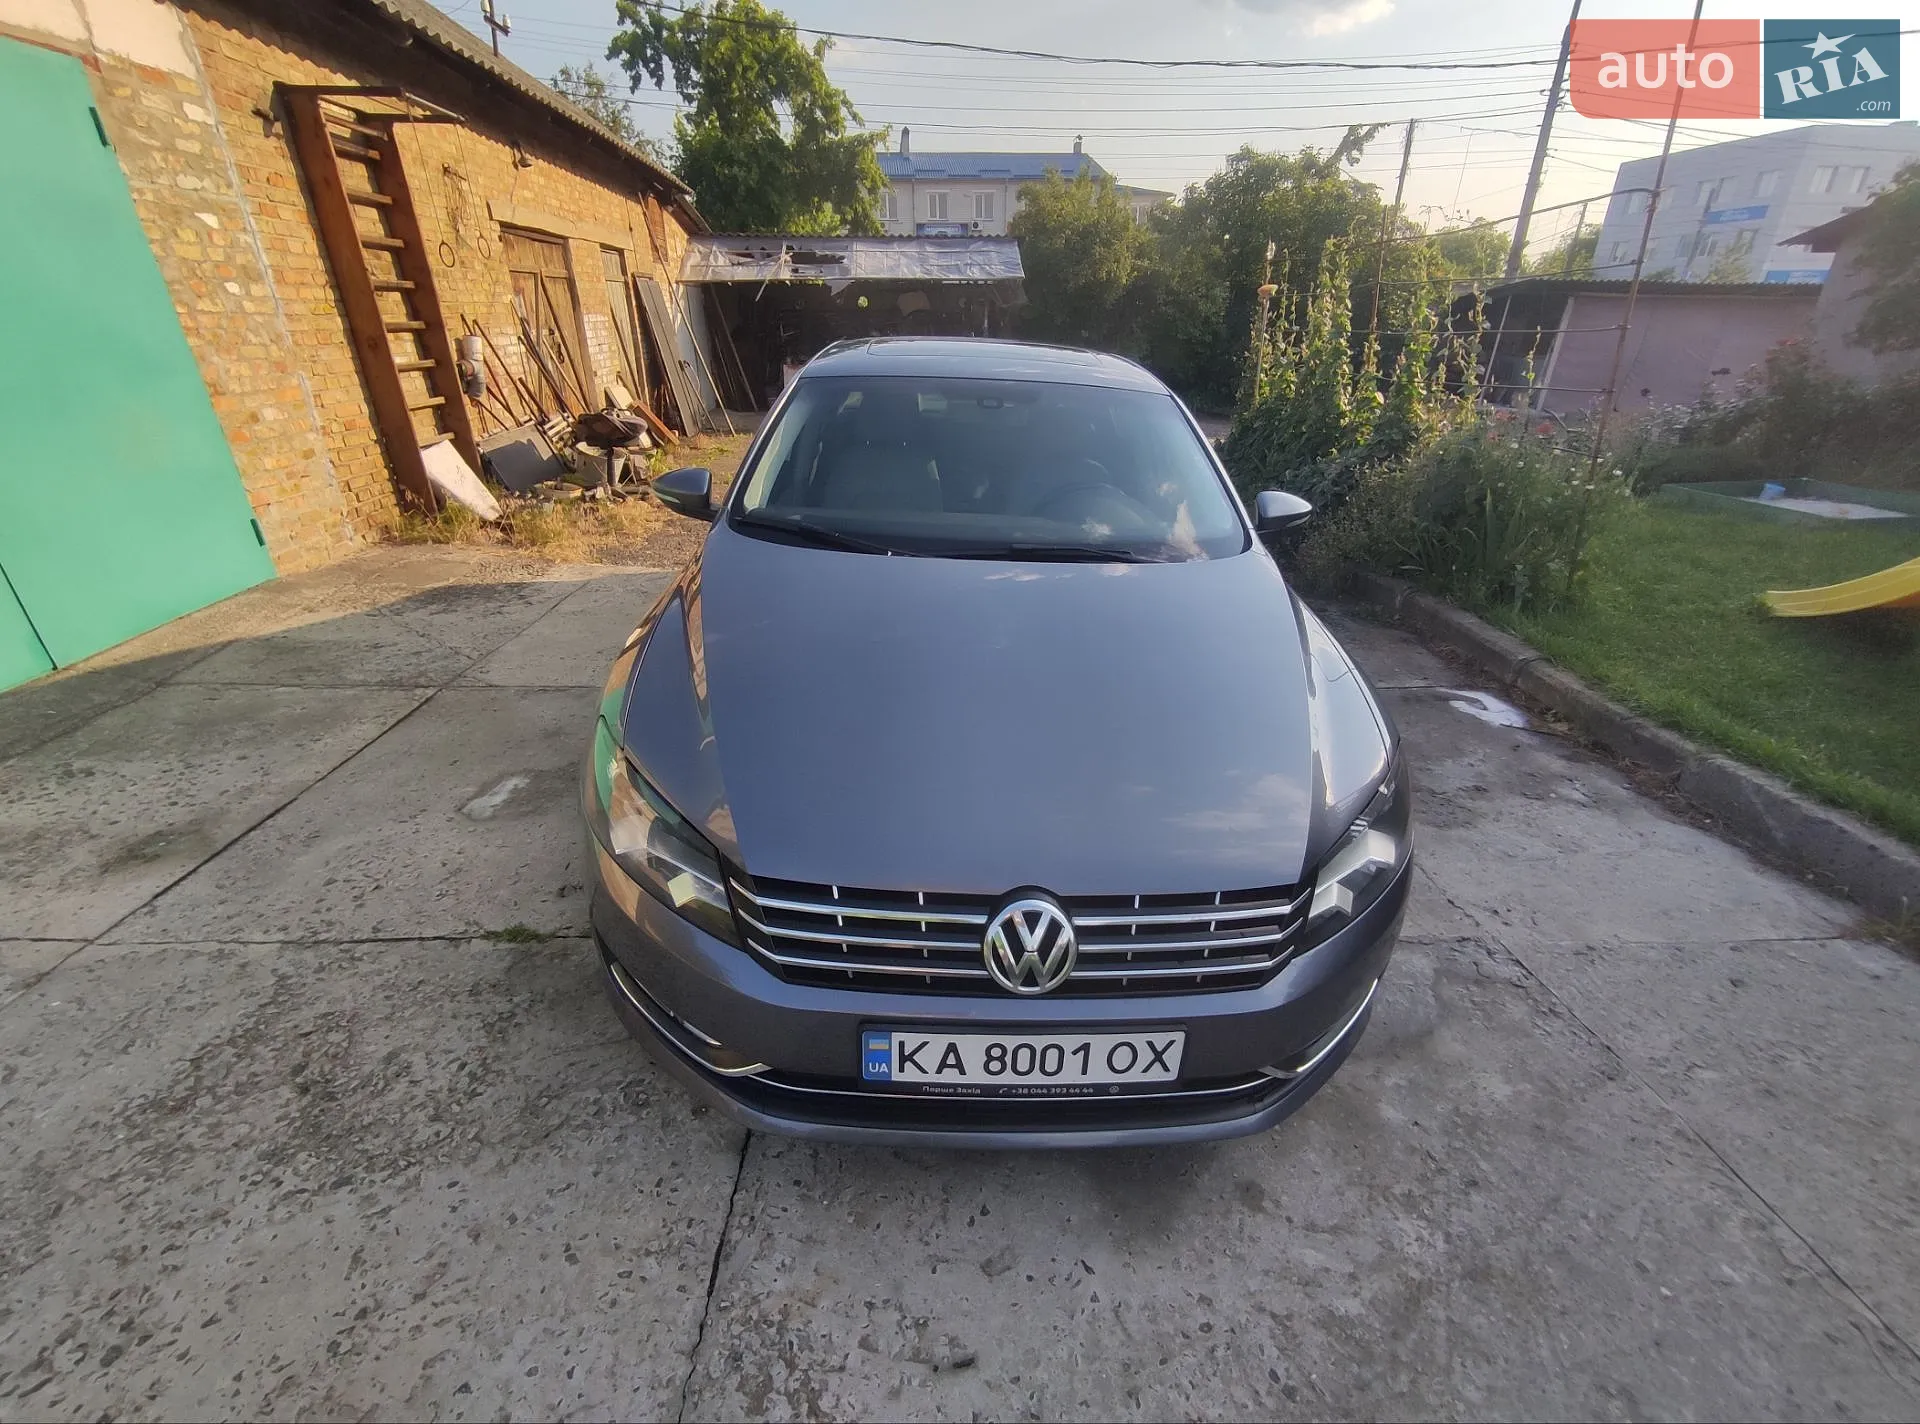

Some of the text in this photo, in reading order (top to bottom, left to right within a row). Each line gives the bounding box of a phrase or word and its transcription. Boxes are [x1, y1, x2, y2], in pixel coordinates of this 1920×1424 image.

[869, 1062, 889, 1073] UA
[898, 1038, 1176, 1077] KA 8001 OX
